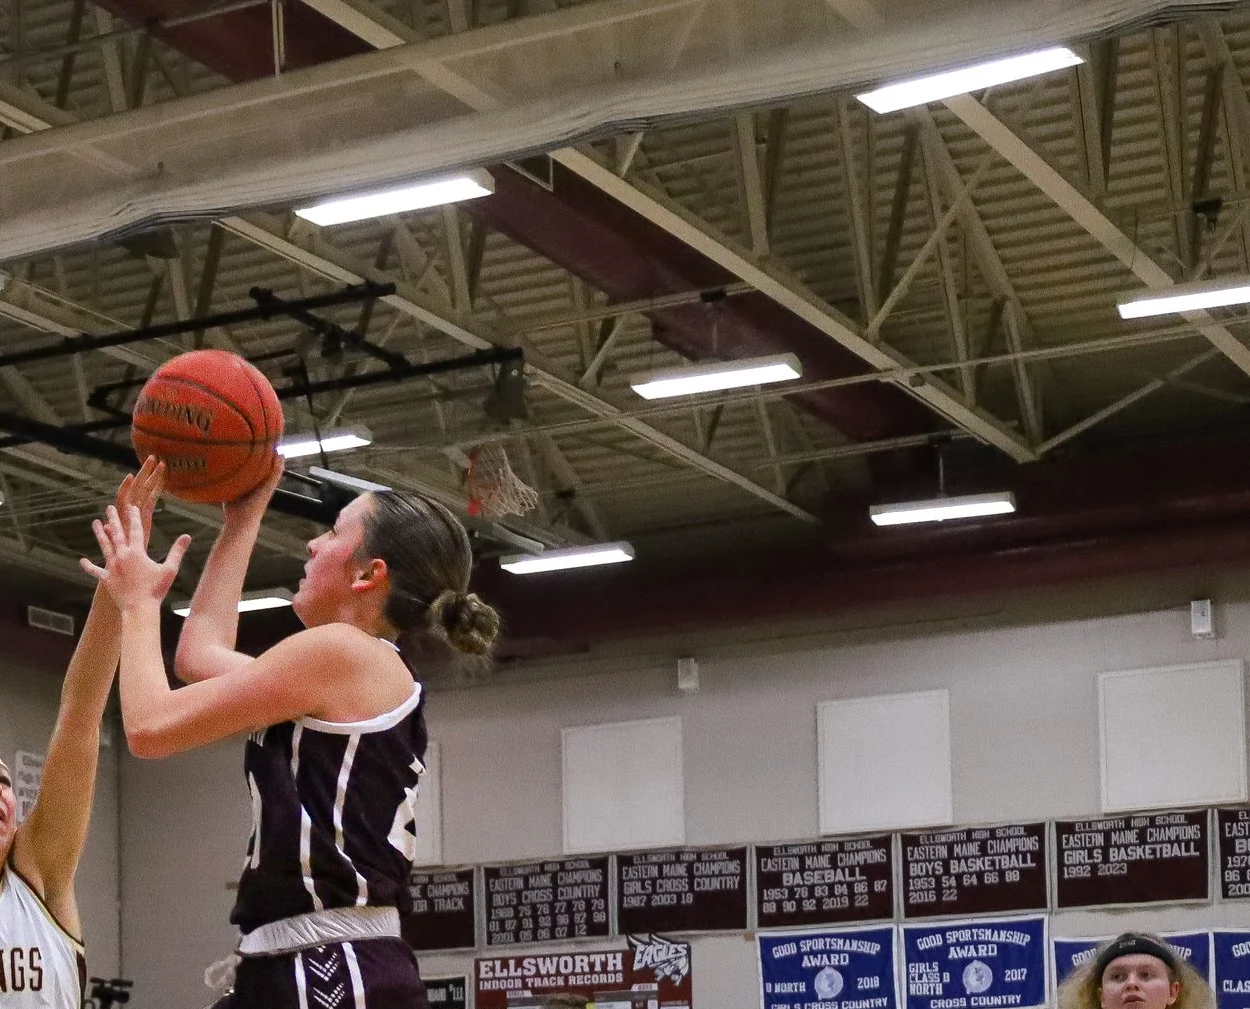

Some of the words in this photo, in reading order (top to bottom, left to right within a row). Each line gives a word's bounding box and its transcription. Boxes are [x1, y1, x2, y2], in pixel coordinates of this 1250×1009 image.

[1075, 818, 1125, 832] ELLSWORTH
[1131, 817, 1150, 827] HIGH
[1155, 814, 1188, 825] SCHOOL
[920, 832, 967, 844] ELLSWORTH
[972, 830, 990, 840] HIGH
[996, 827, 1026, 838] SCHOOL
[1062, 832, 1104, 849] EASTERN
[1111, 829, 1140, 845] MAINE
[1147, 825, 1201, 841] CHAMPIONS
[907, 845, 948, 861] EASTERN
[954, 841, 982, 857] MAINE
[987, 836, 1039, 854] CHAMPIONS
[1064, 849, 1102, 865] GIRLS
[1109, 841, 1199, 862] BASKETBALL
[761, 857, 799, 872] EASTERN
[805, 854, 831, 869] MAINE
[837, 849, 887, 866] CHAMPIONS
[909, 861, 943, 876] BOYS
[950, 853, 1036, 874] BASKETBALL
[529, 874, 552, 888] MAINE
[558, 869, 602, 884] CHAMPIONS
[622, 865, 658, 880] EASTERN
[663, 863, 688, 877] MAINE
[693, 860, 740, 875] CHAMPIONS
[783, 867, 866, 886] BASEBALL
[1064, 865, 1091, 879] 1992
[1098, 862, 1127, 876] 2023
[522, 888, 552, 902] CROSS
[558, 885, 600, 899] COUNTRY
[623, 880, 652, 895] GIRLS
[656, 878, 689, 893] CROSS
[694, 876, 740, 891] COUNTRY
[854, 894, 869, 906] 22
[942, 889, 958, 901] 22
[434, 897, 464, 911] TRACK
[772, 942, 797, 958] GOOD
[800, 937, 881, 955] SPORTSMANSHIP
[917, 934, 943, 950] GOOD
[946, 928, 1031, 946] SPORTSMANSHIP
[633, 942, 687, 970] EAGLES
[948, 944, 997, 959] AWARD
[478, 952, 623, 979] ELLSWORTH
[802, 953, 849, 968] AWARD
[909, 962, 939, 973] GIRLS
[479, 977, 522, 990] INDOOR
[526, 975, 565, 988] TRACK
[569, 972, 623, 985] RECORDS
[909, 973, 940, 983] CLASS
[1005, 968, 1027, 981] 2017
[774, 982, 806, 993] NORTH
[909, 983, 943, 996] NORTH
[841, 997, 888, 1009] COUNTRY
[930, 997, 967, 1009] CROSS
[971, 995, 1021, 1006] COUNTRY
